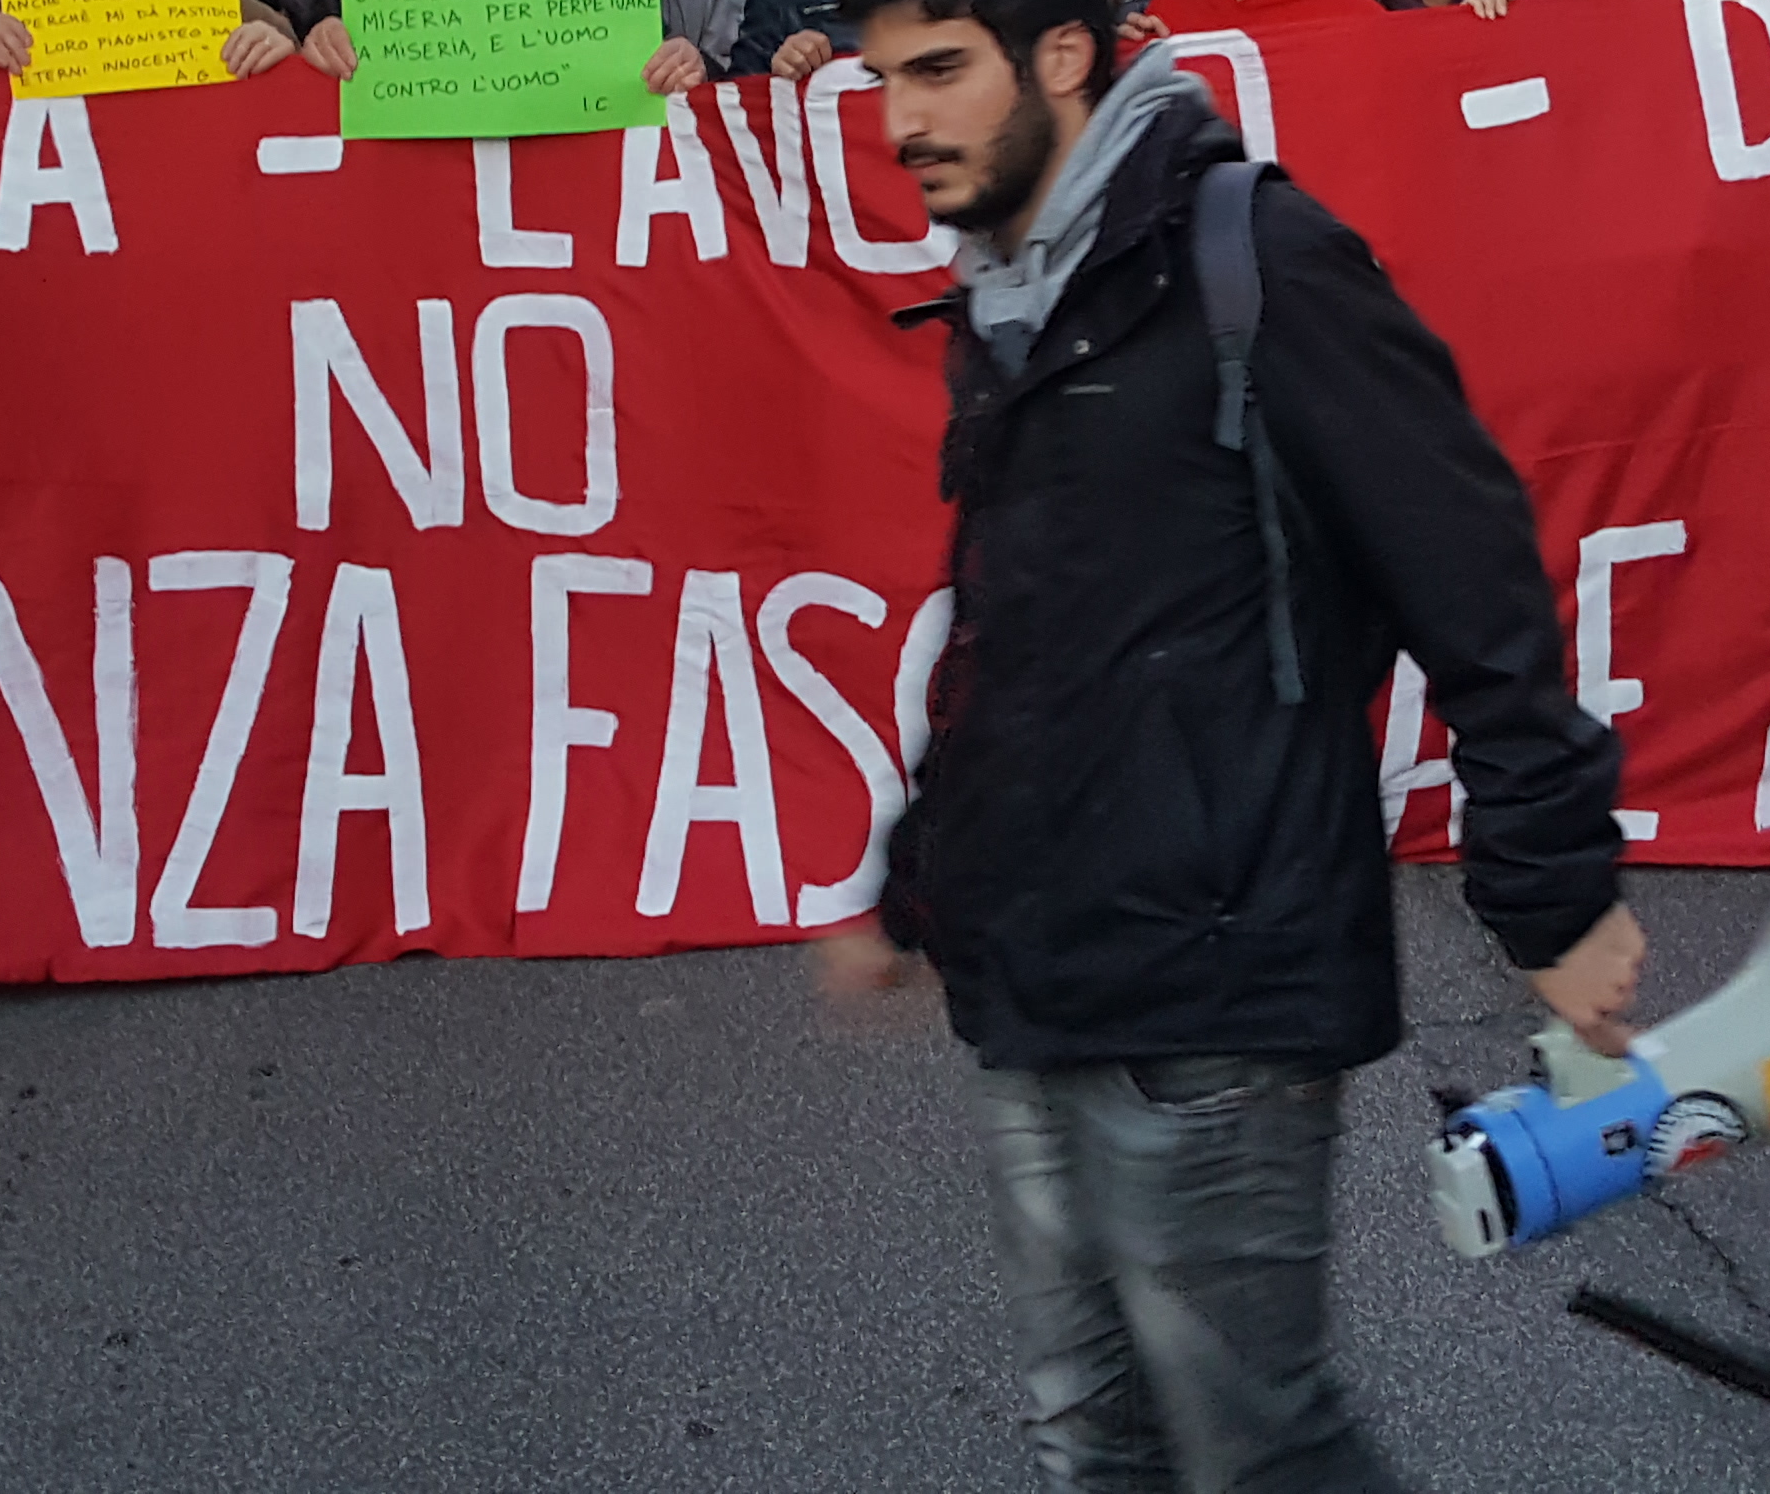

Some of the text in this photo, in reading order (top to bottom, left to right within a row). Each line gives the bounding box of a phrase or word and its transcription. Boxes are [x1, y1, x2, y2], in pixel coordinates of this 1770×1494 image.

[486, 2, 531, 24] PER
[44, 38, 89, 56] LORO
[490, 33, 505, 55] E
[521, 25, 610, 49] L'UOMO
[373, 77, 459, 101] CONTRO
[290, 292, 620, 537] NO
